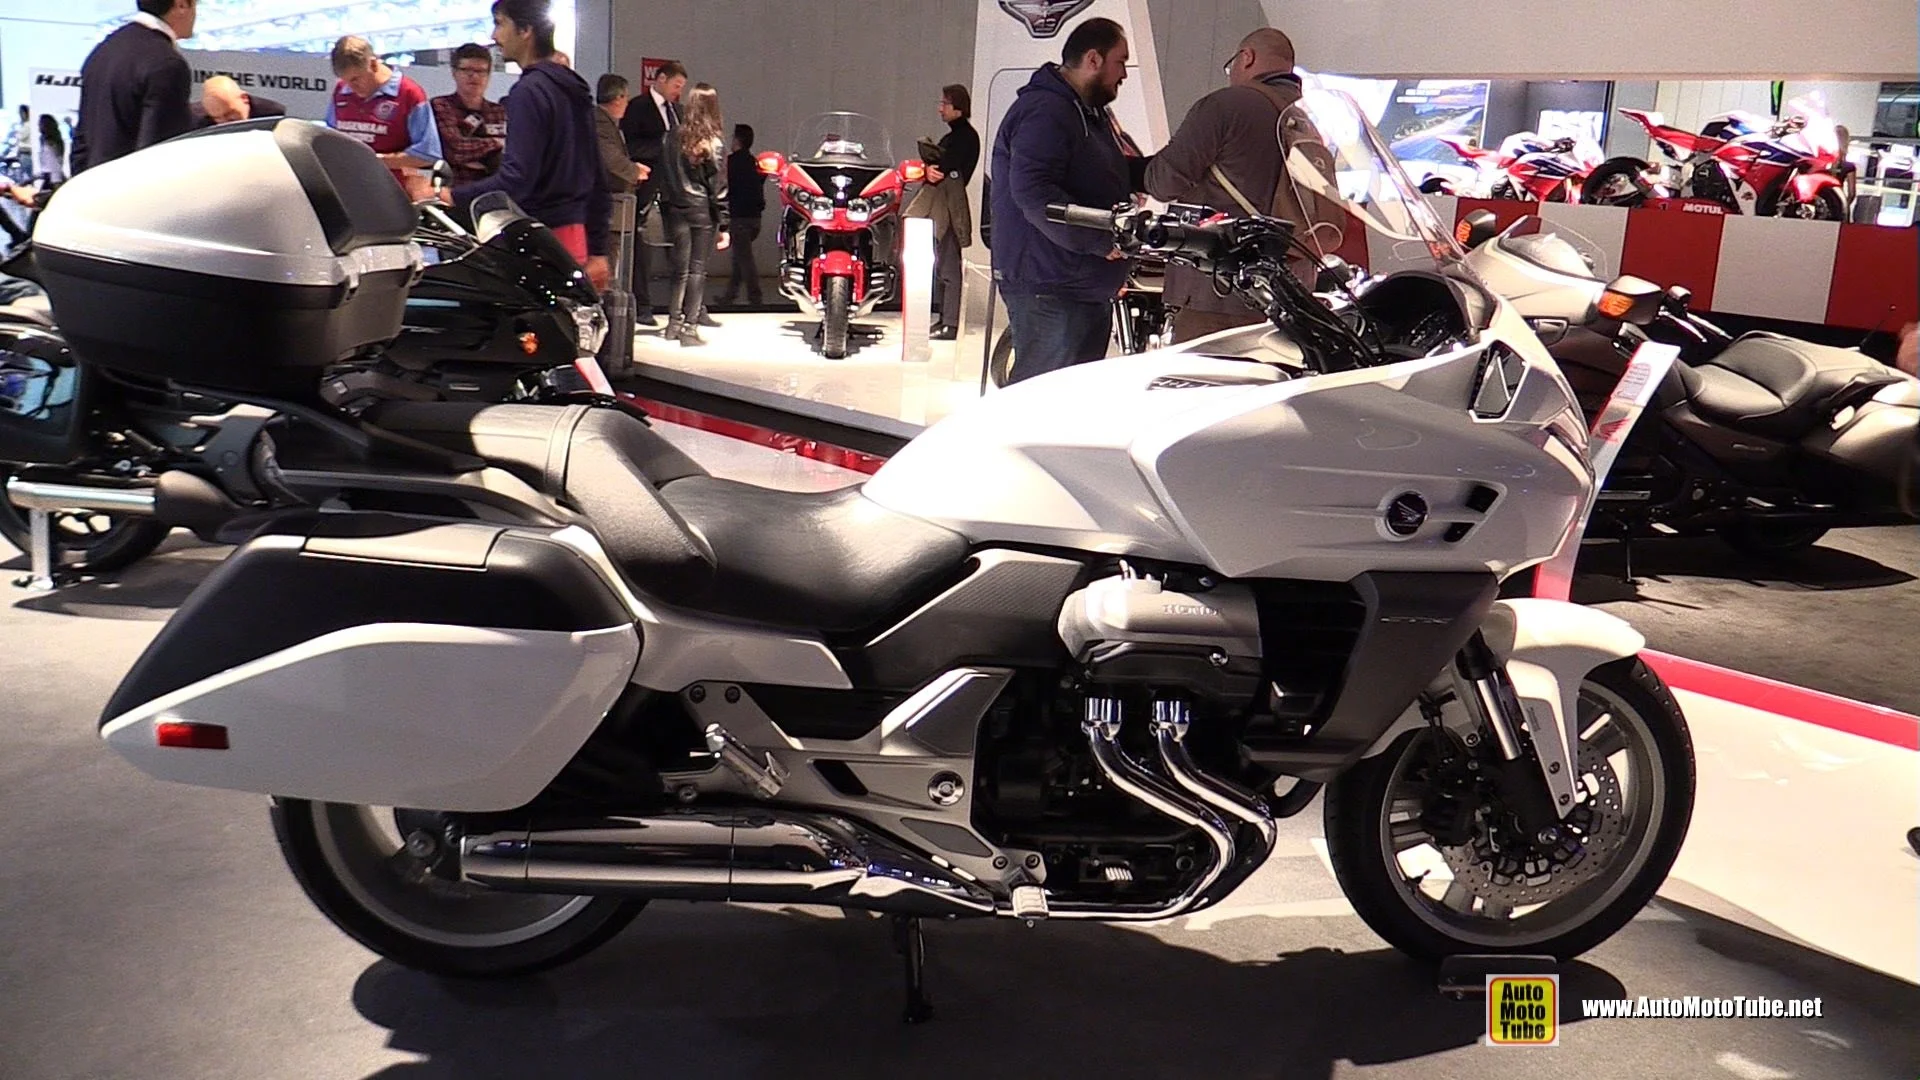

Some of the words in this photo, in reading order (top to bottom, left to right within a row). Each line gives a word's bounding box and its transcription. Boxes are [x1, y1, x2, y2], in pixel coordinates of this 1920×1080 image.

[215, 71, 255, 87] HE
[257, 74, 327, 92] WORLD
[1682, 202, 1724, 215] MOTUL
